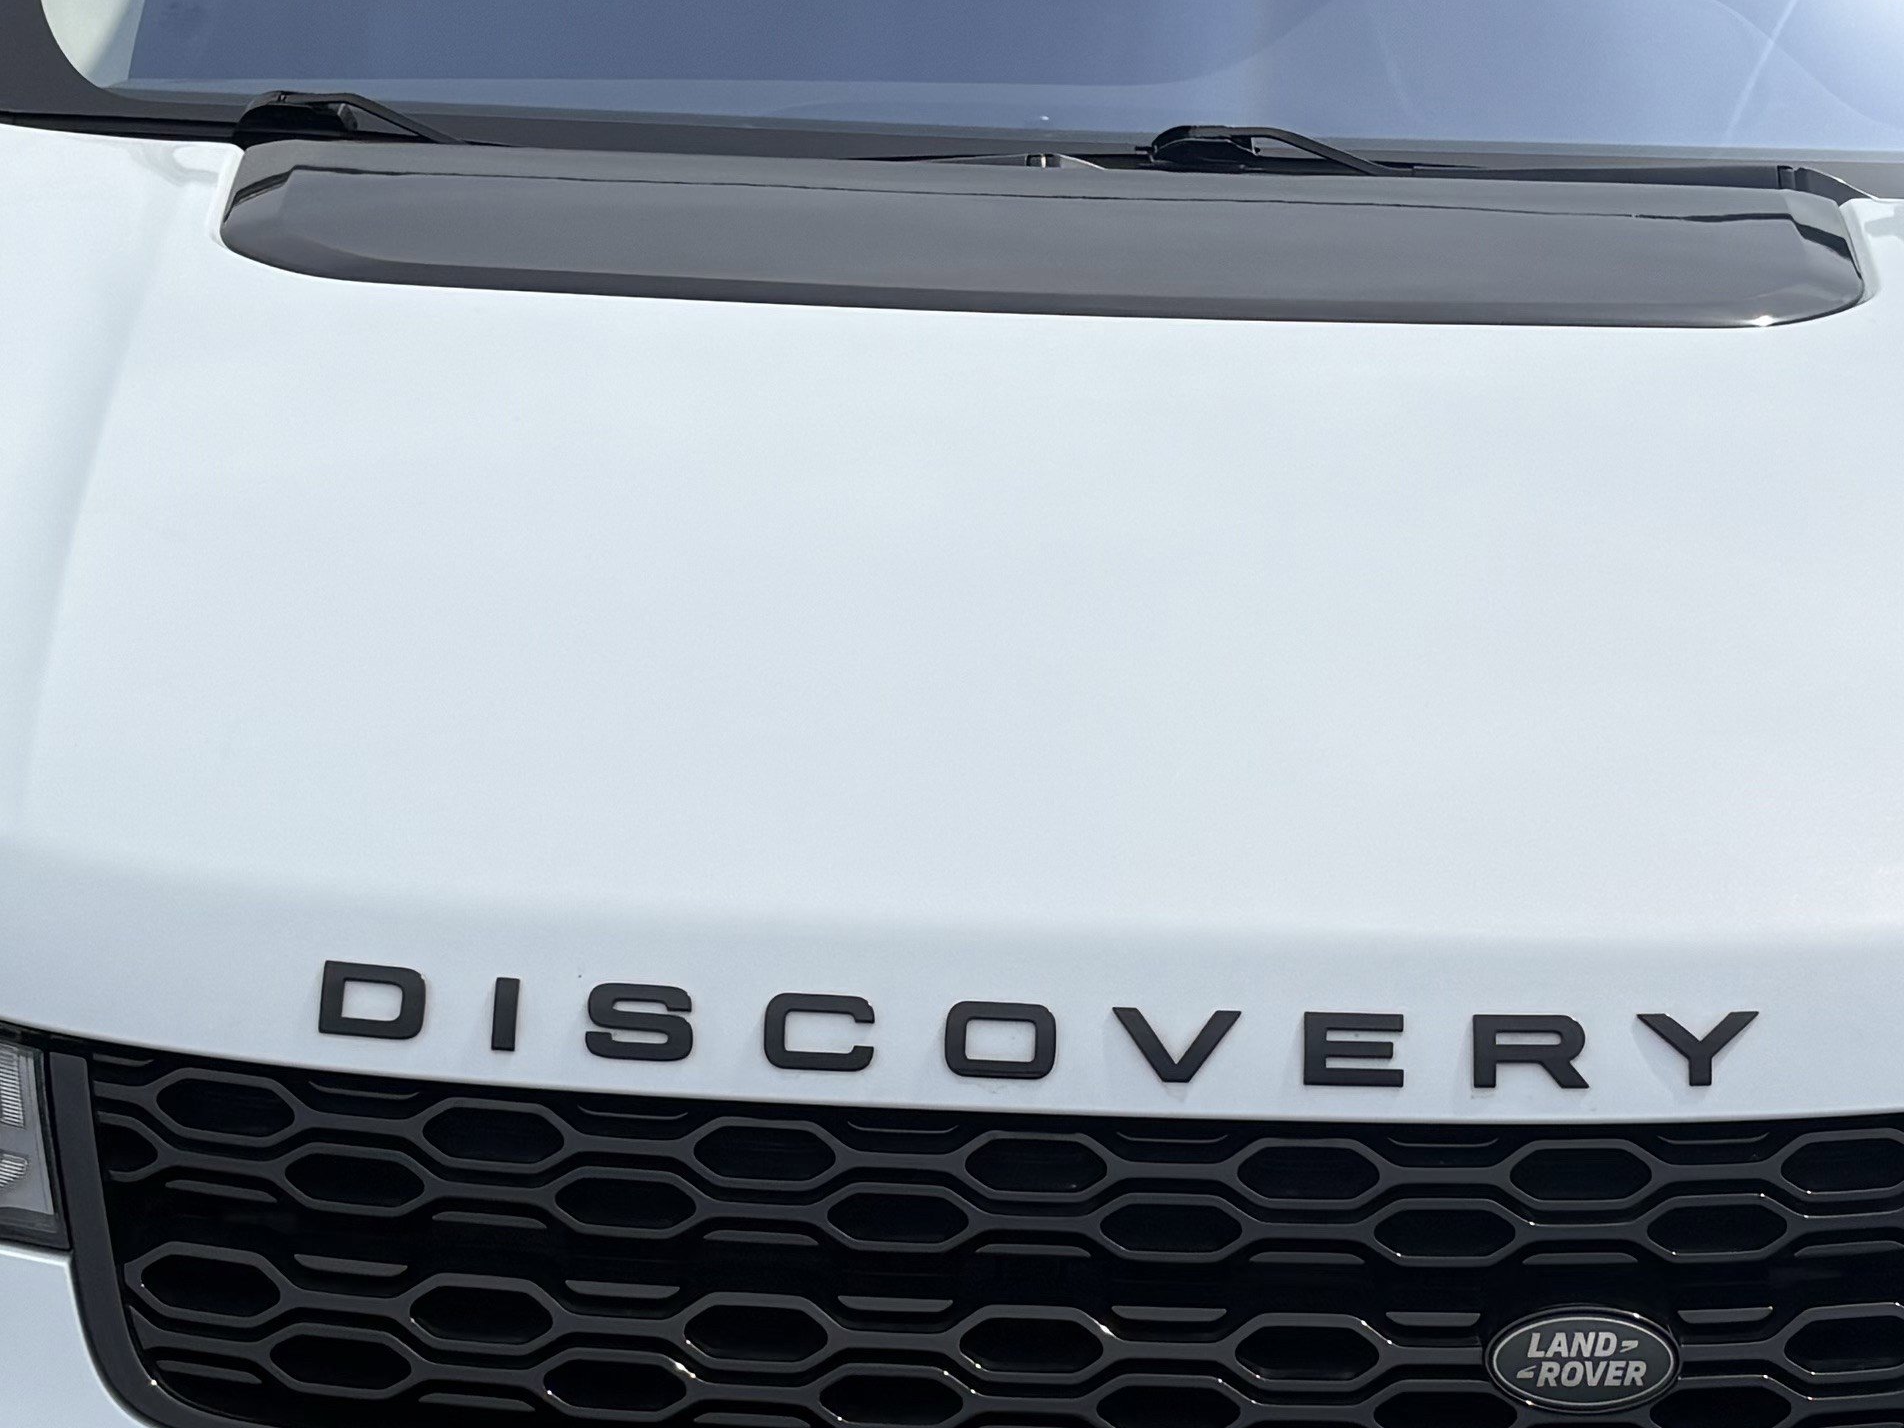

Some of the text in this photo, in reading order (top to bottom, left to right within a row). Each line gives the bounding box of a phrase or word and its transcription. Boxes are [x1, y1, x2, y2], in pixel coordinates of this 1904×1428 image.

[318, 960, 1758, 1090] DISCOVERY
[1527, 1331, 1618, 1358] LAND
[1536, 1360, 1647, 1388] ROVER
